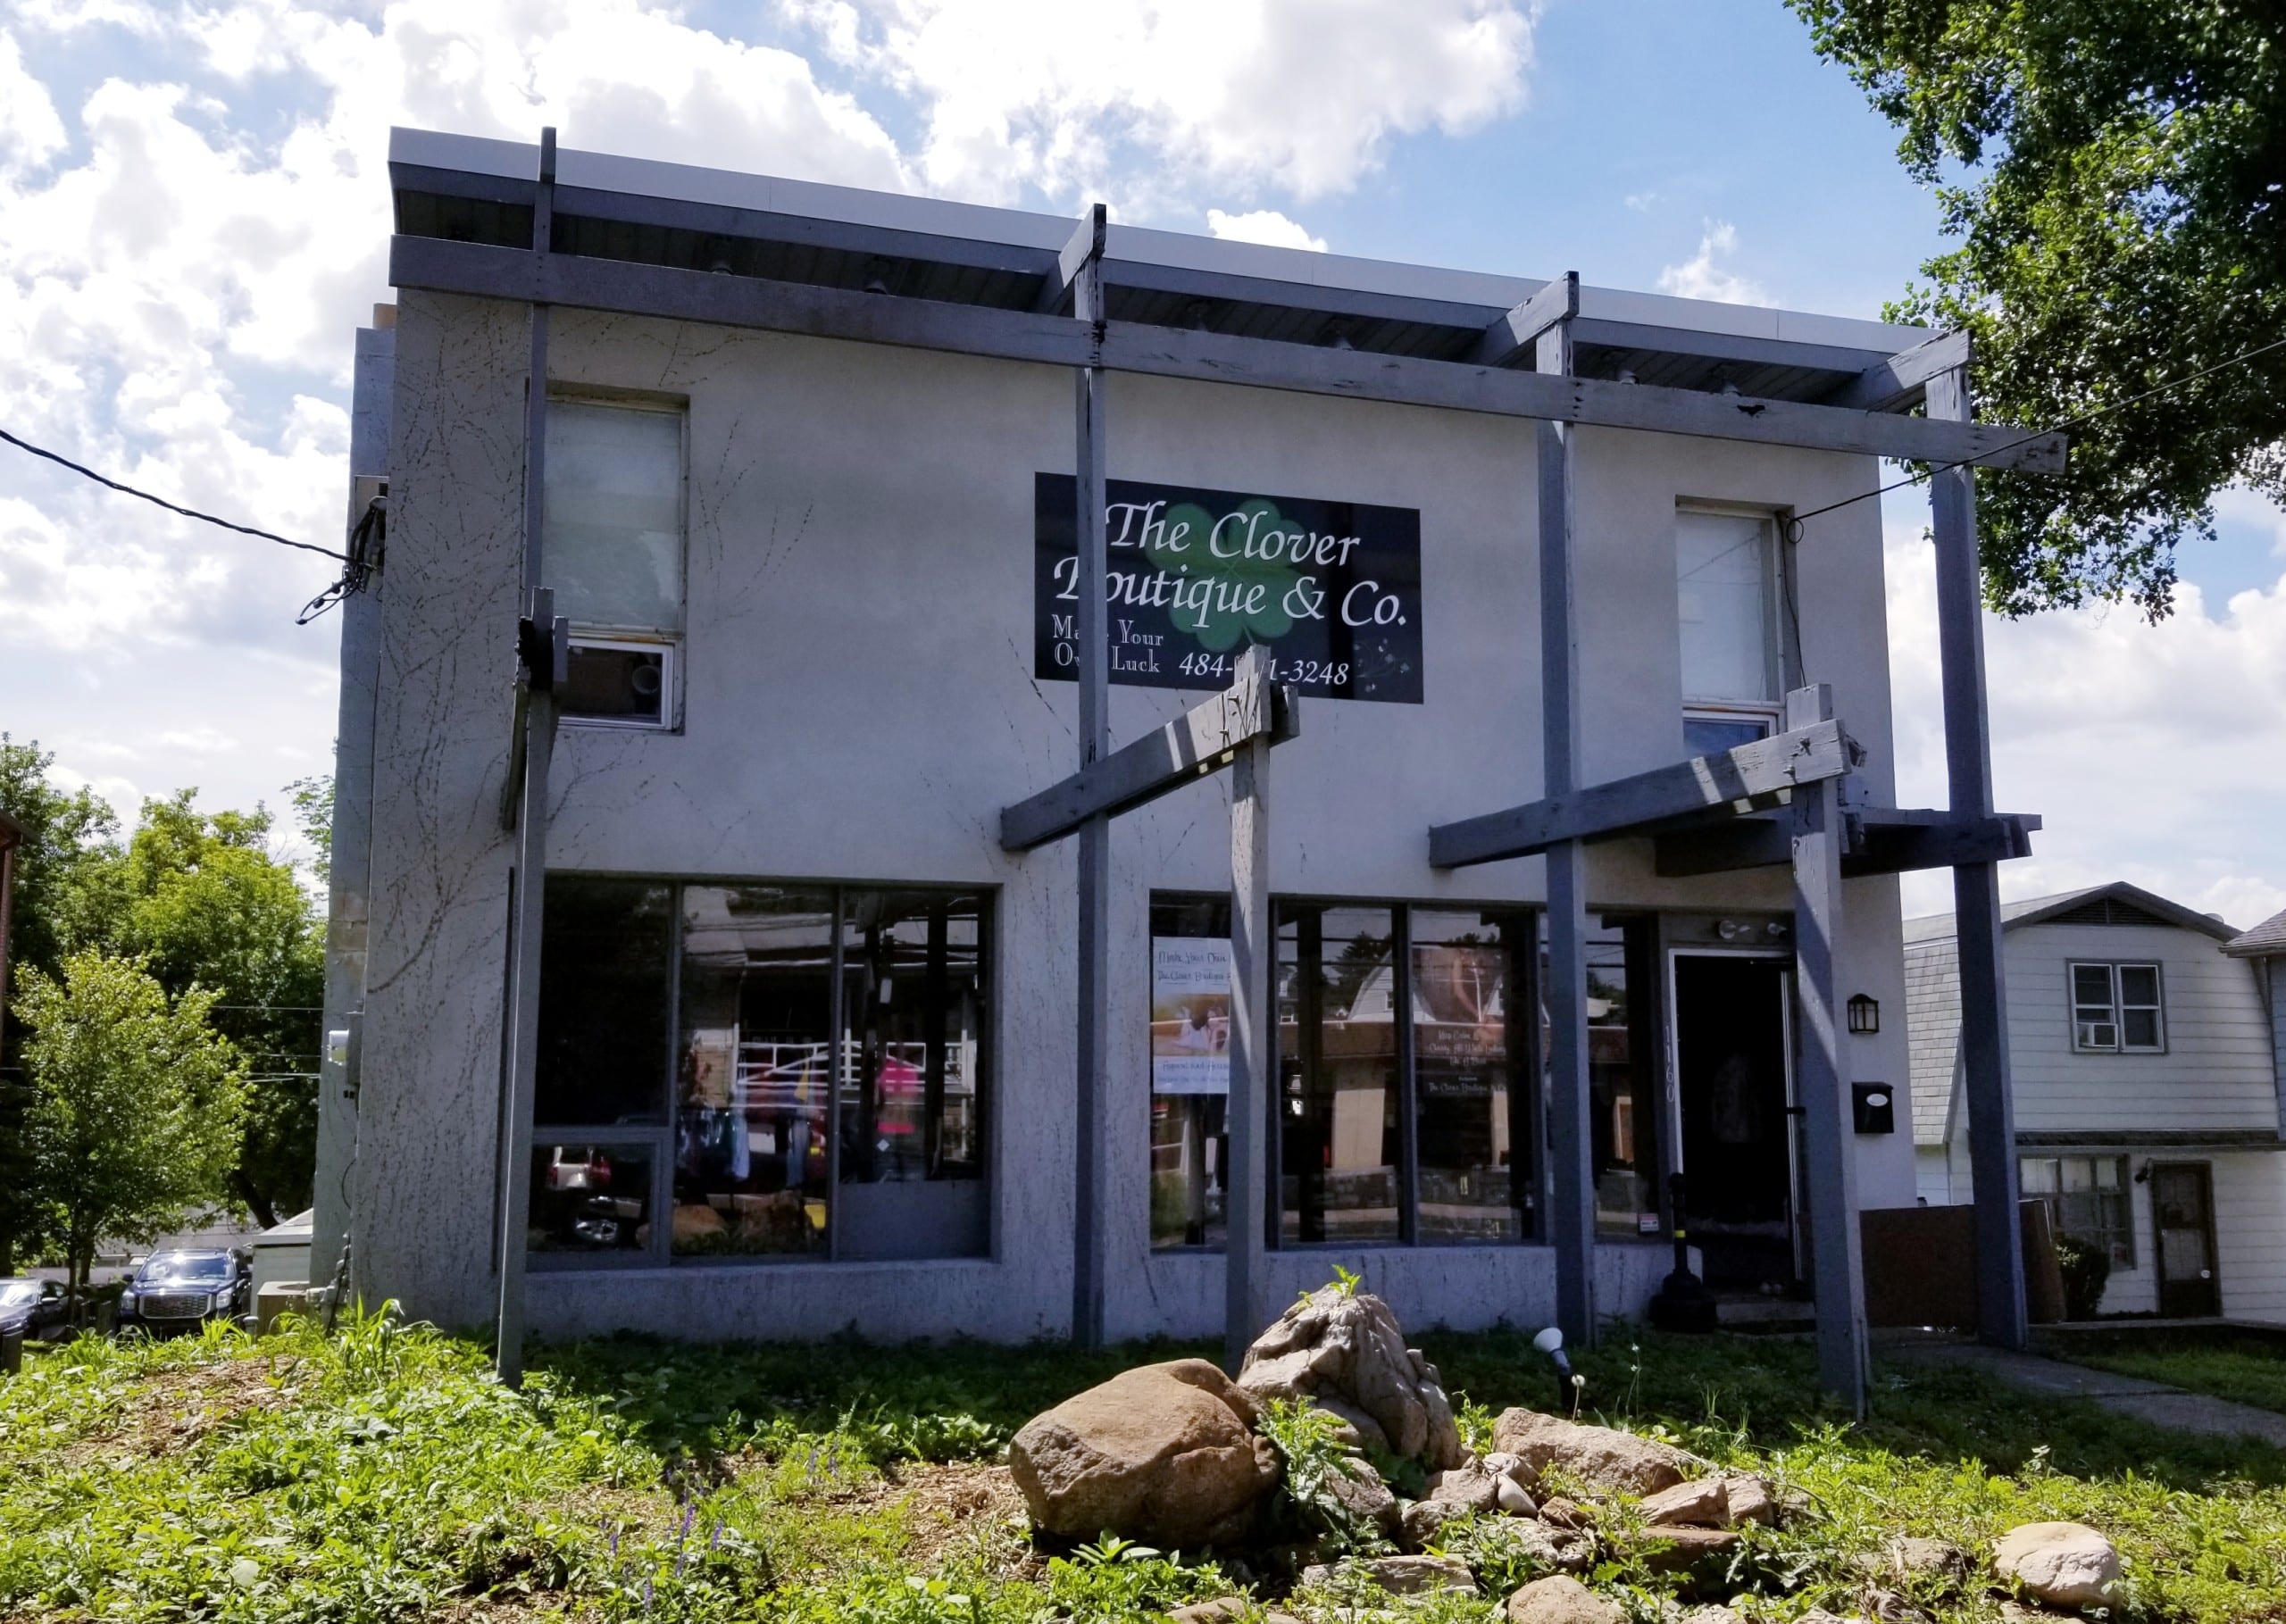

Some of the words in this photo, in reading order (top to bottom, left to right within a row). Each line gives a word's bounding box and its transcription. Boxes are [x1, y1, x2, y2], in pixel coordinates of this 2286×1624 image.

[1105, 500, 1191, 553] The
[1209, 510, 1361, 567] Clover
[1282, 576, 1326, 620] &
[1341, 580, 1406, 627] Co.
[1117, 619, 1164, 646] Your
[1111, 645, 1161, 673] Luck
[1179, 652, 1349, 686] 484-1-3248
